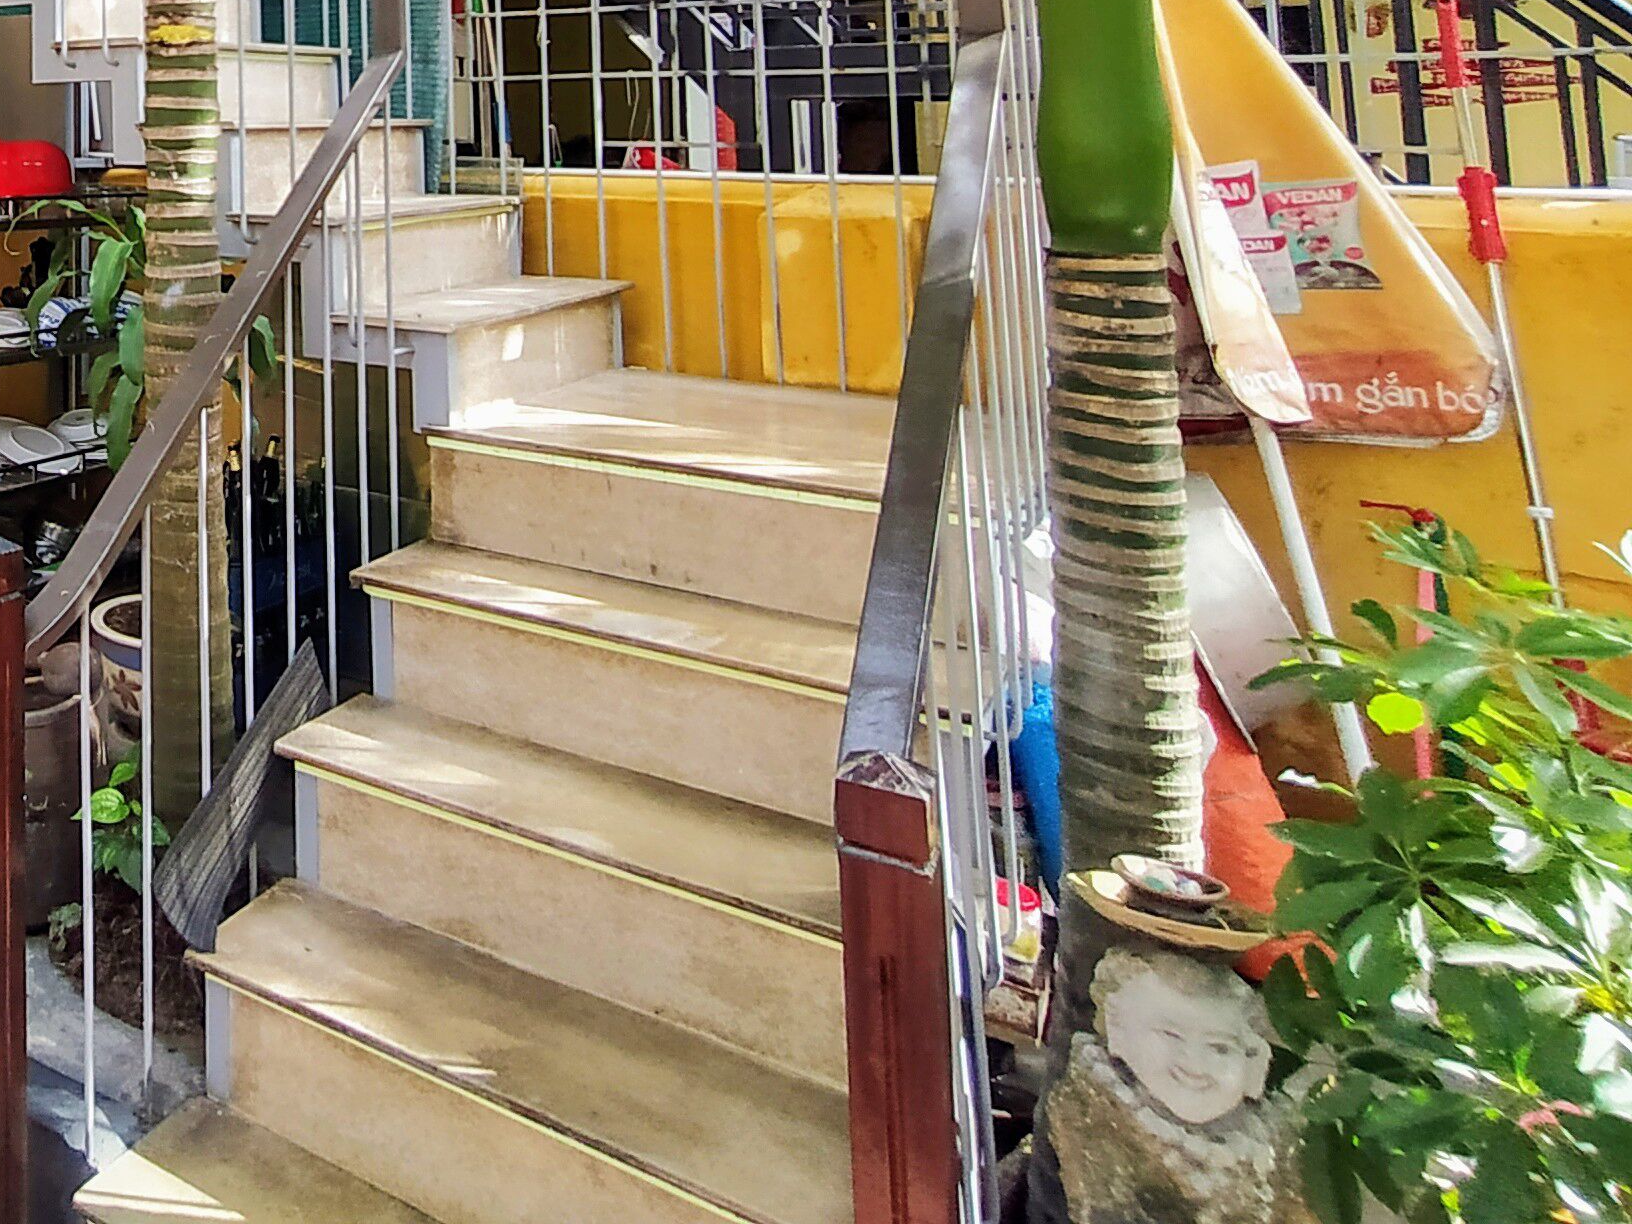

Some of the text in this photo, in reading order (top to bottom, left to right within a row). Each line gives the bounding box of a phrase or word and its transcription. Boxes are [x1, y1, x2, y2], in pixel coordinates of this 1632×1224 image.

[1275, 187, 1342, 204] VEDAN
[1243, 238, 1275, 251] DAN
[1309, 381, 1344, 403] m
